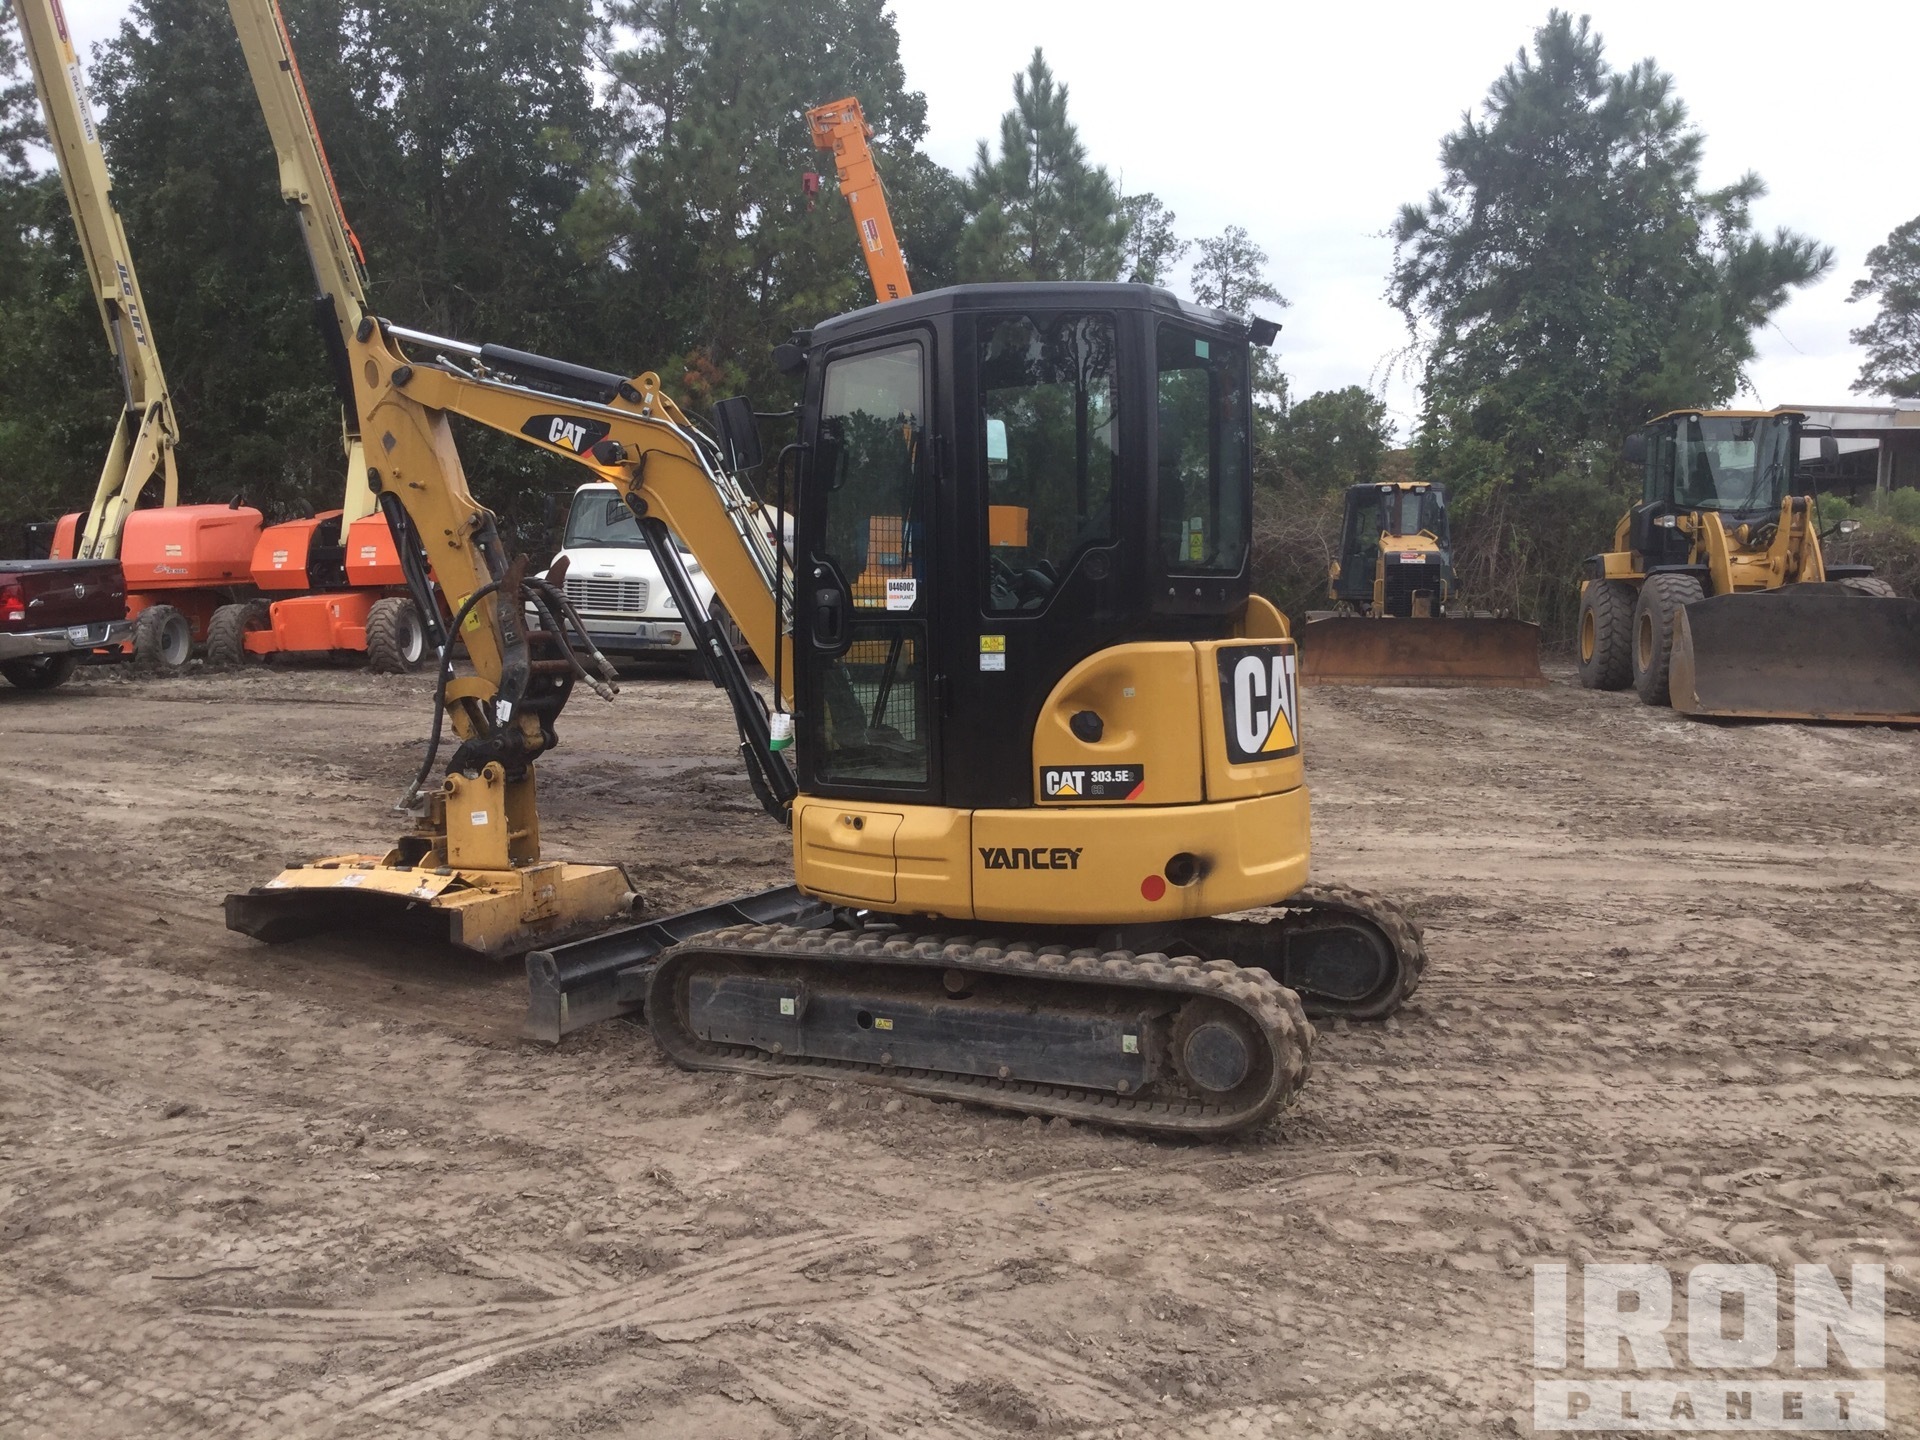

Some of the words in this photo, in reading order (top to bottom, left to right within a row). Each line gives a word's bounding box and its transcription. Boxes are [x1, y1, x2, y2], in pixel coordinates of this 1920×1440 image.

[116, 260, 133, 297] JLG
[128, 304, 147, 346] LIFT
[548, 417, 587, 452] CAT
[888, 582, 915, 592] U446002
[1234, 655, 1298, 754] CAT
[1046, 770, 1085, 795] CAT
[978, 847, 1084, 870] YANCEY
